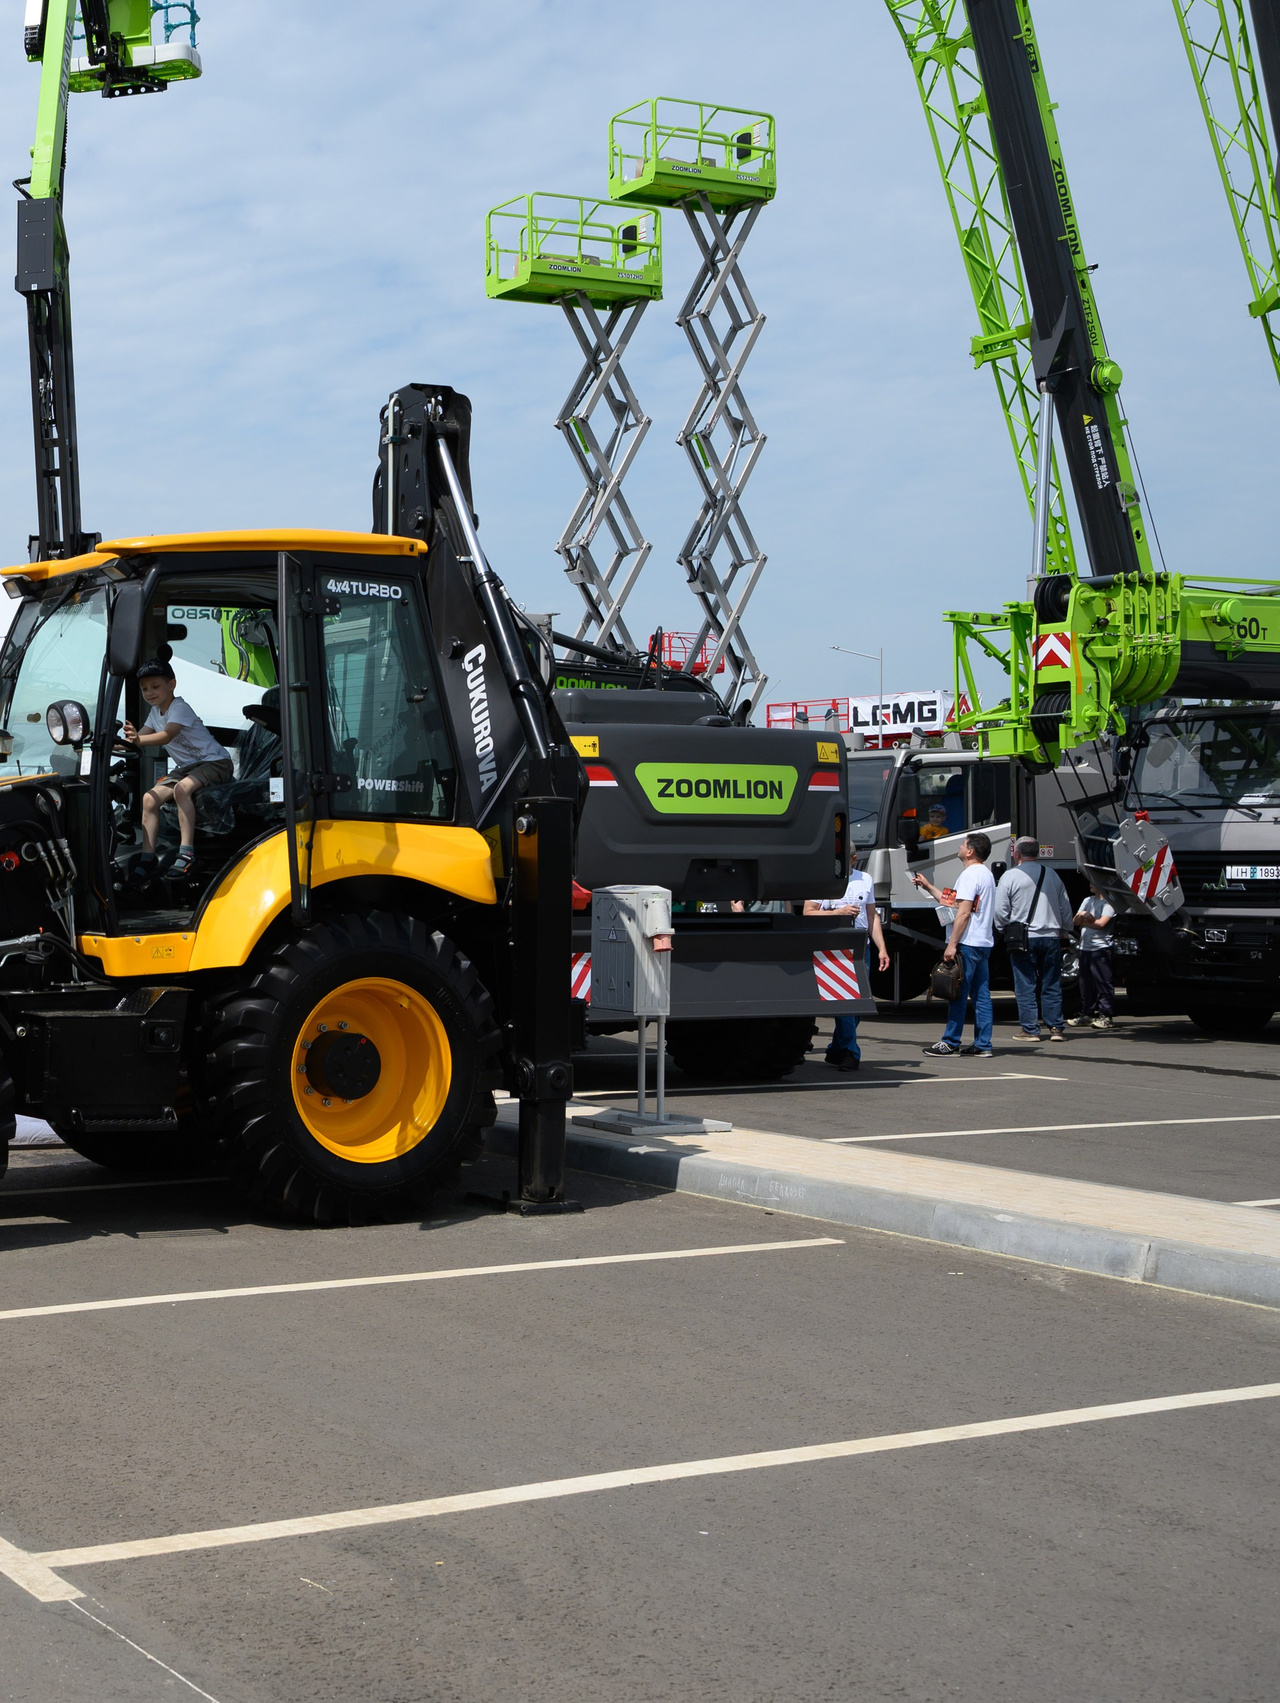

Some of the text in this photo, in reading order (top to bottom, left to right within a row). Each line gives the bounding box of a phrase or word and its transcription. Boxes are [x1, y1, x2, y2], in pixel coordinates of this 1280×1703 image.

[671, 164, 702, 174] ZOOMLION
[1051, 157, 1081, 256] ZOOMLION
[548, 263, 582, 273] ZOOMLION
[1081, 298, 1099, 347] ZTF250V
[461, 643, 498, 794] ÇUKUROVA
[852, 700, 937, 727] LGMG
[656, 778, 783, 800] ZOOMLION
